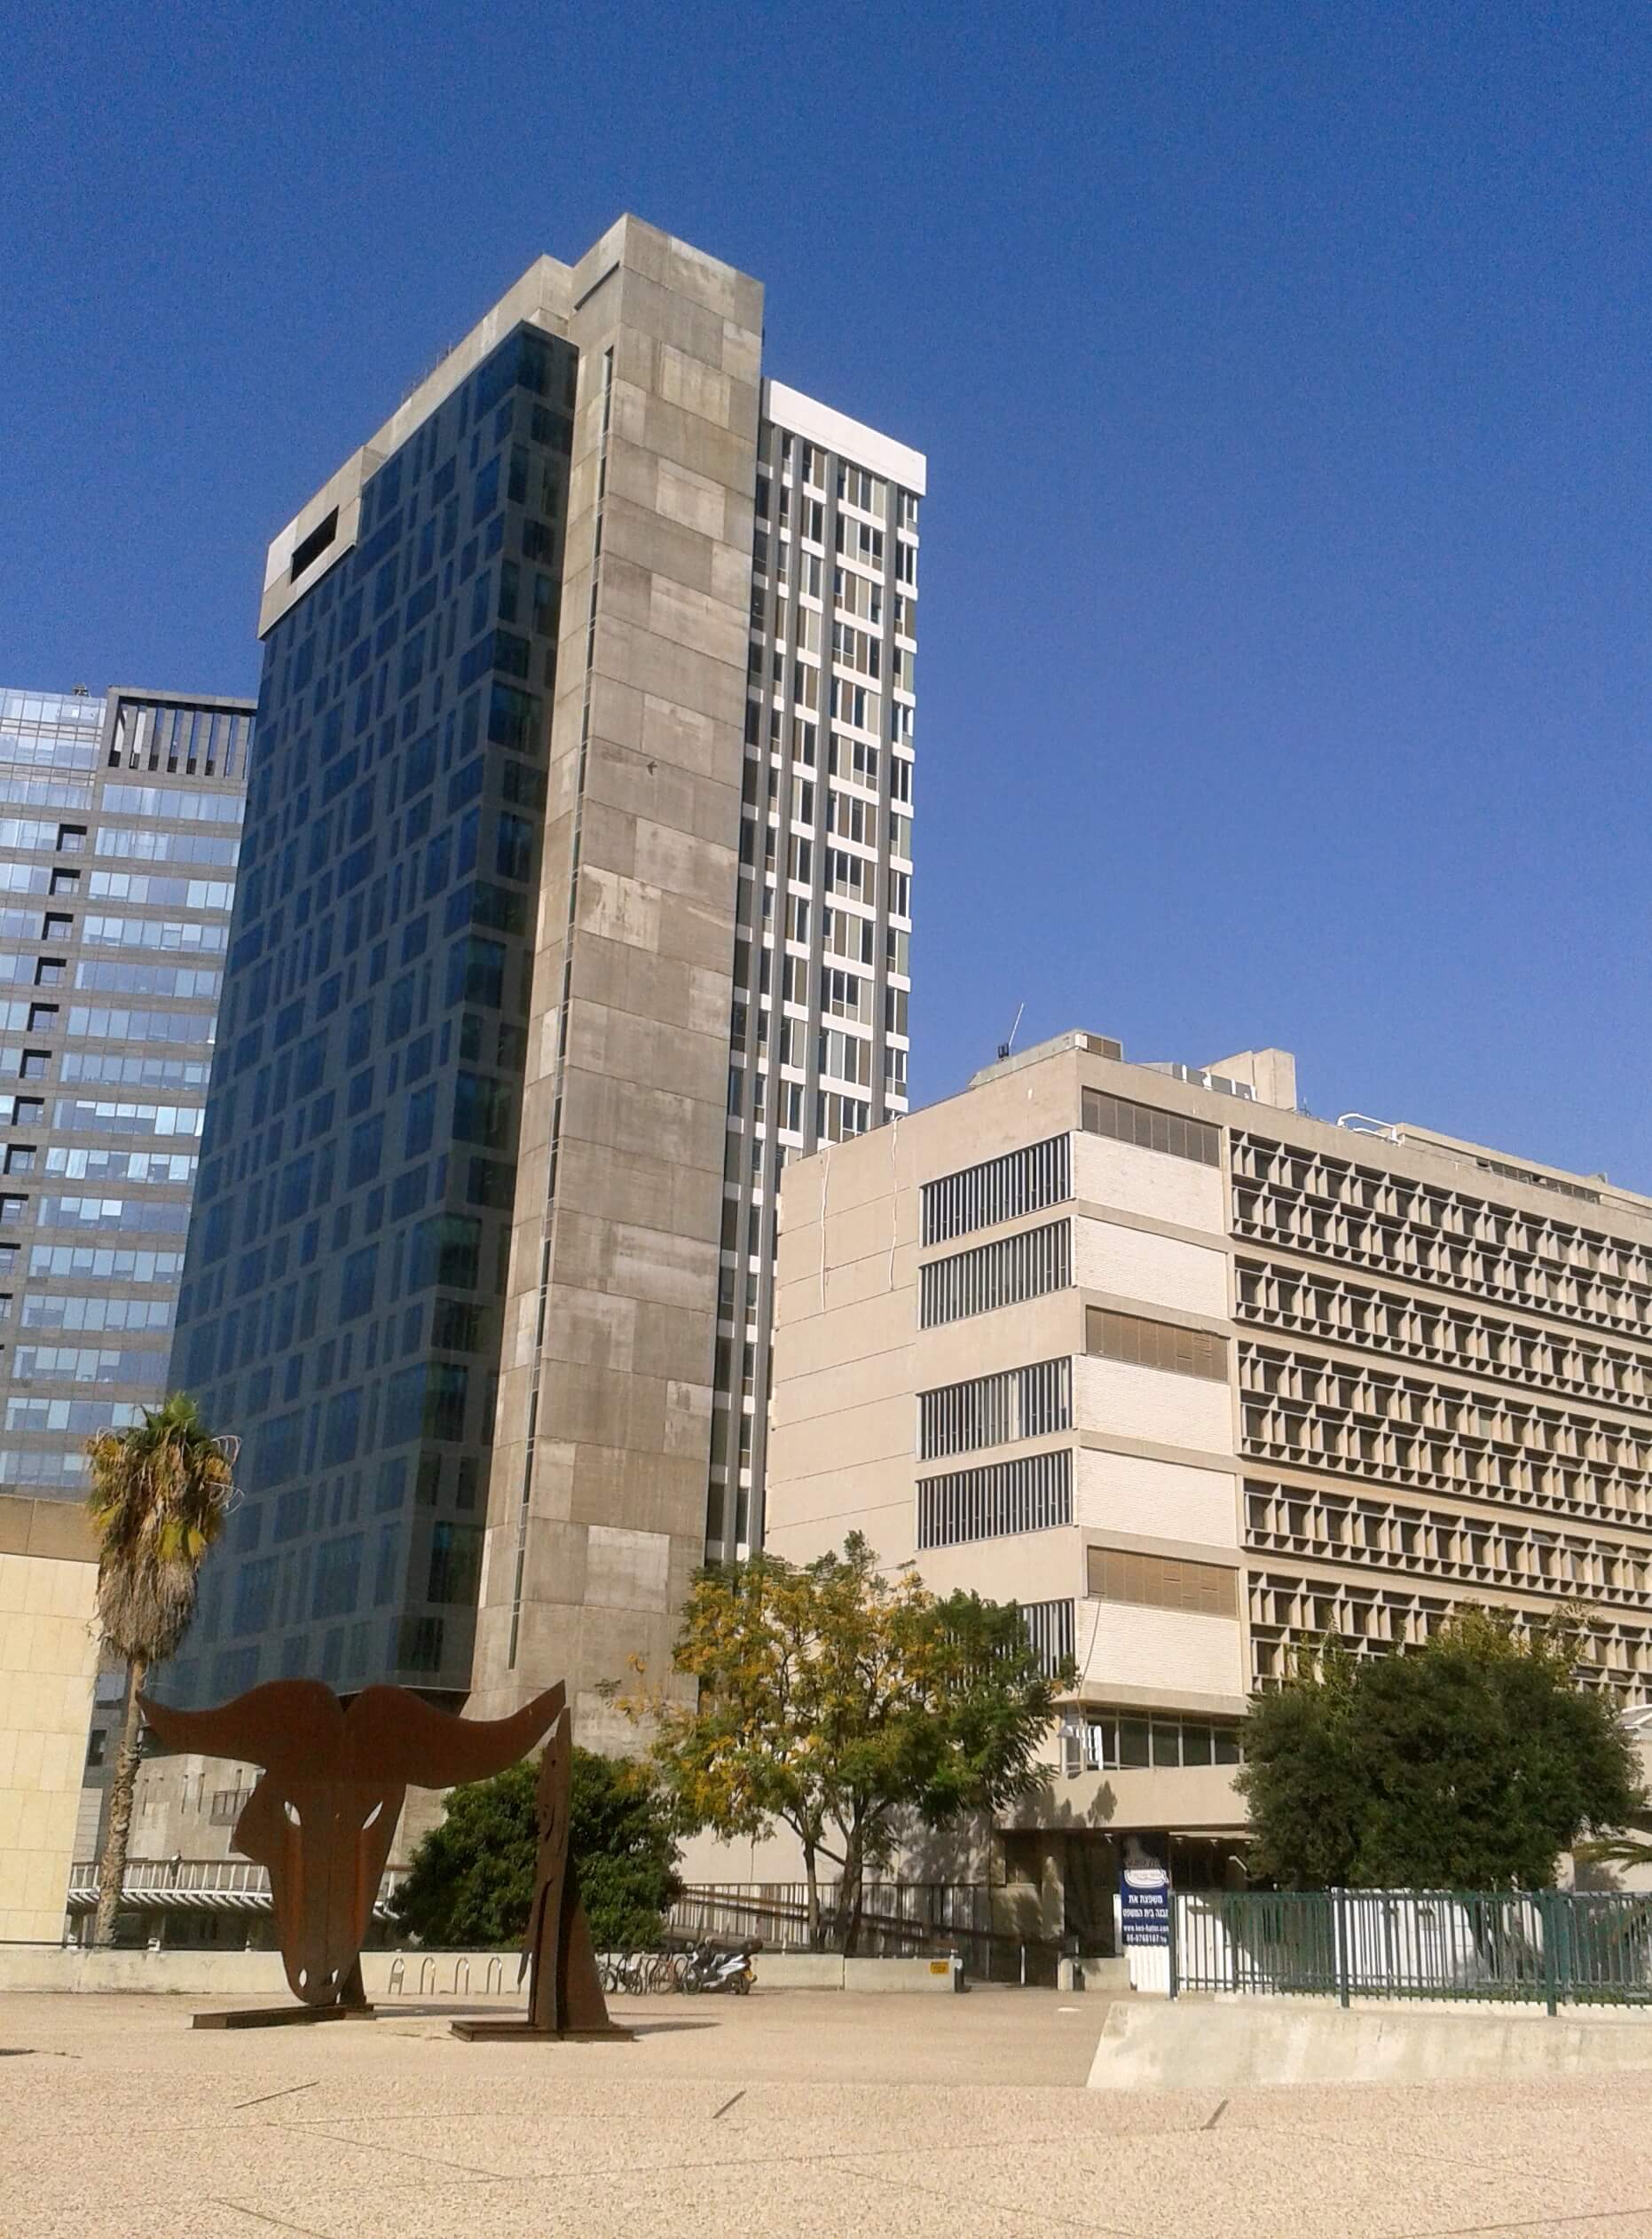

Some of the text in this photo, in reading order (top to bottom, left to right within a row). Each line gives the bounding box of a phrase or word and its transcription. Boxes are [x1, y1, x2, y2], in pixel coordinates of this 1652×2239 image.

[1129, 1894, 1163, 1904] משפצת את
[1122, 1908, 1143, 1919] המשפט
[1144, 1908, 1154, 1918] בית
